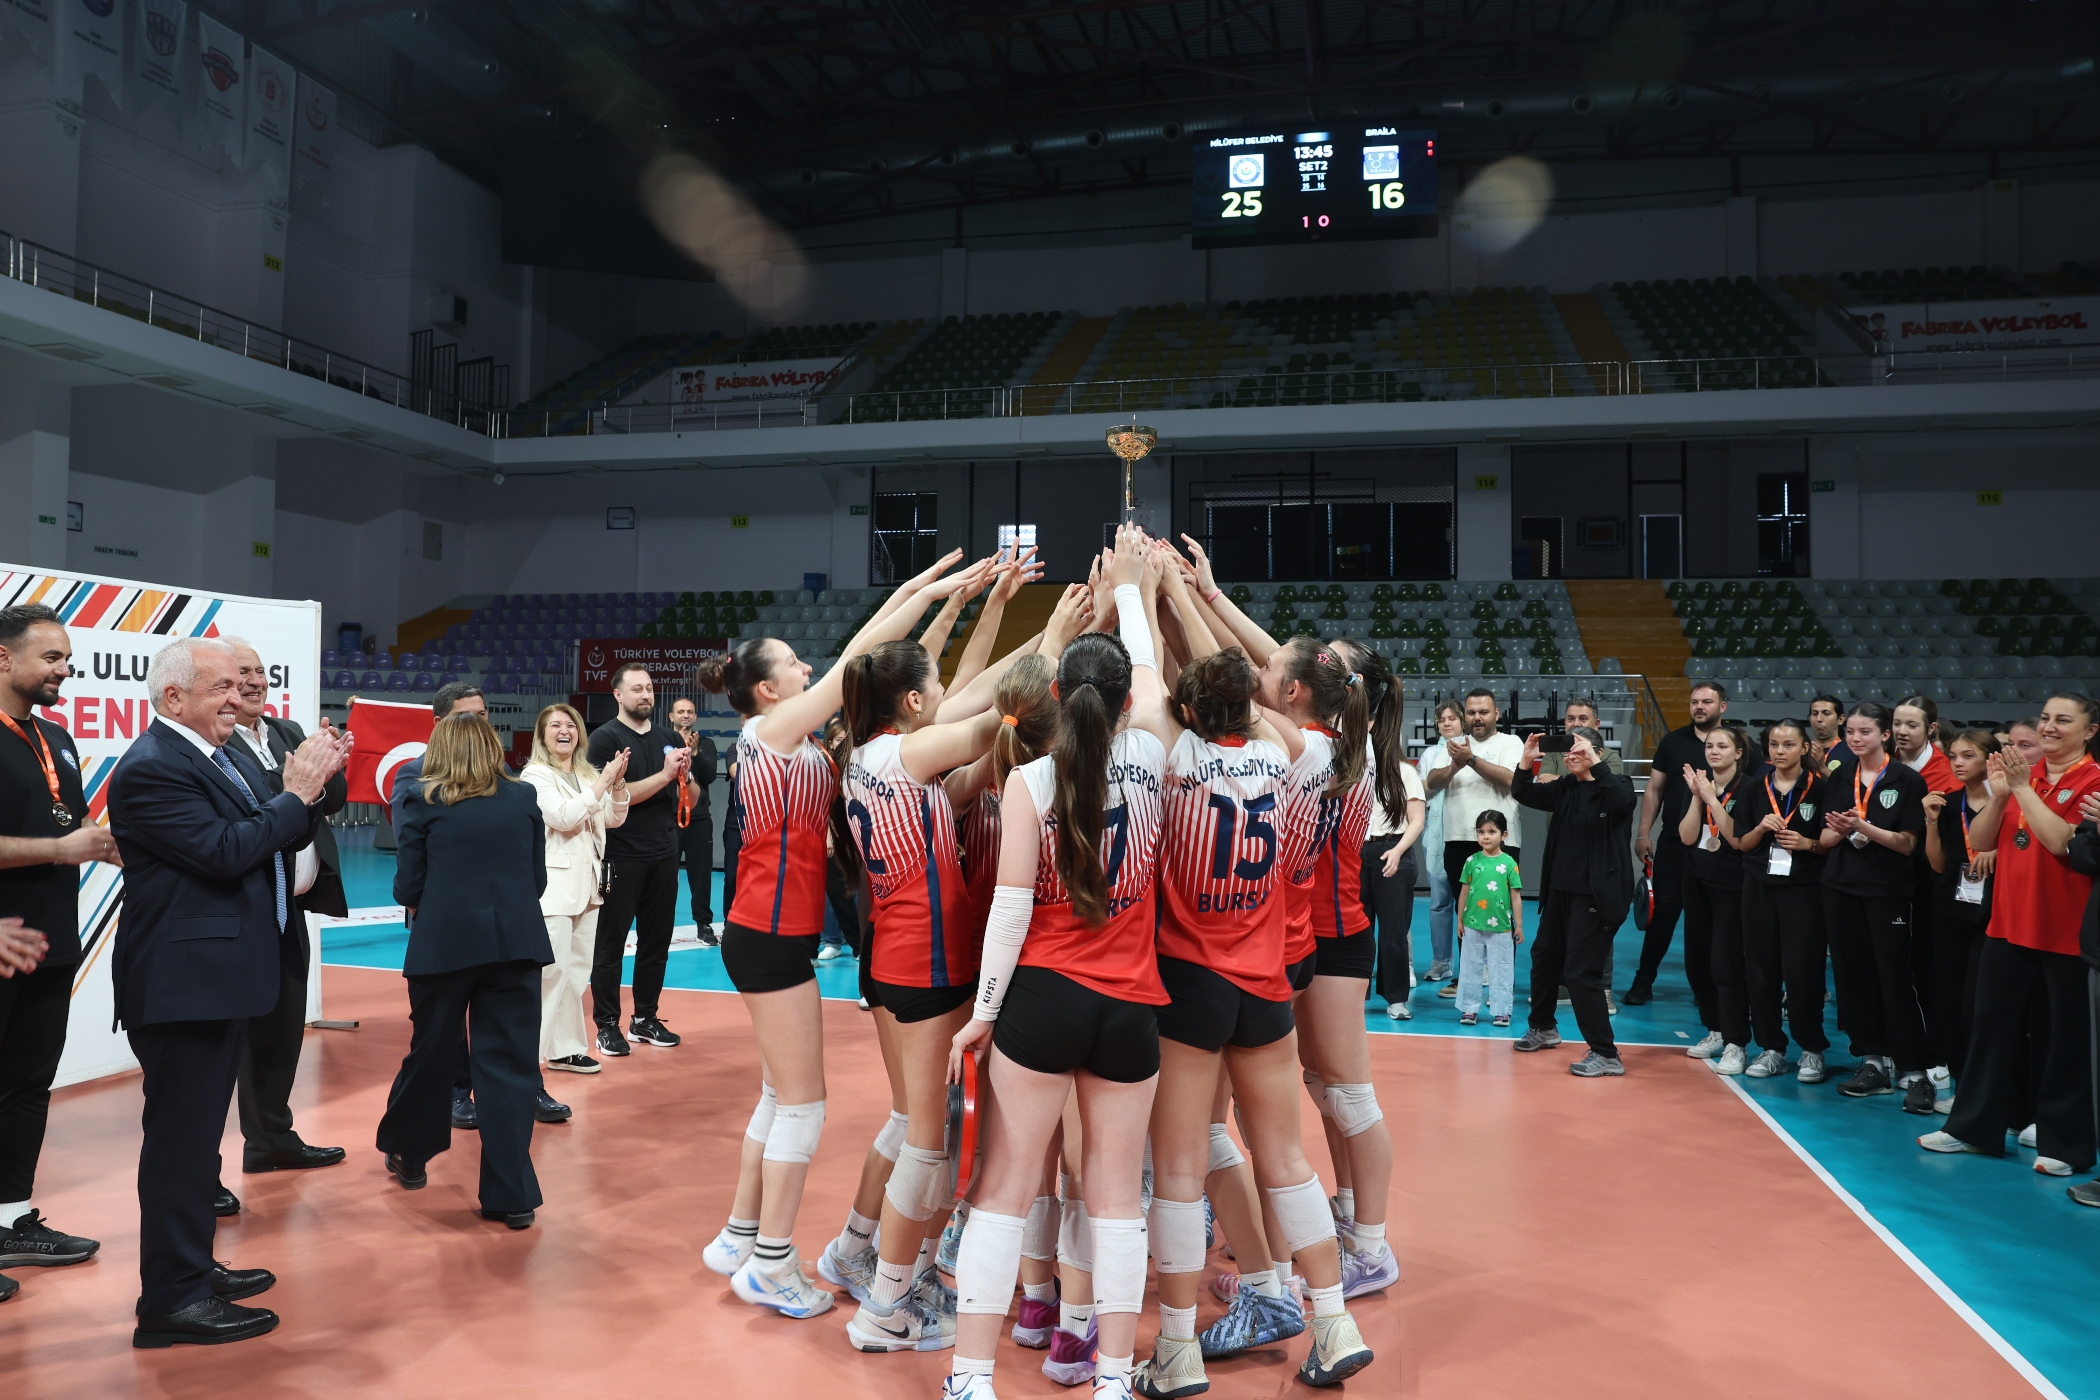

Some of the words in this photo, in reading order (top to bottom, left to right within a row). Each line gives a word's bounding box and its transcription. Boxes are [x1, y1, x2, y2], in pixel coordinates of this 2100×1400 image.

[1245, 134, 1284, 145] BELEDİYE
[1294, 145, 1333, 159] 13:45
[1299, 161, 1328, 172] SET2
[1368, 182, 1405, 210] 16
[1221, 190, 1263, 218] 25
[1302, 215, 1309, 228] 1
[1318, 214, 1330, 227] 0
[266, 257, 280, 270] 212
[1979, 311, 2088, 334] VOLEYBOL
[1478, 478, 1495, 487] 114
[1980, 494, 1999, 503] 115
[733, 518, 747, 526] 113
[94, 545, 114, 555] HAKEM
[255, 545, 268, 555] 112
[613, 647, 660, 659] TÜRKİYE
[584, 670, 608, 682] TVF
[847, 798, 886, 875] 2
[1208, 791, 1277, 881] 15
[982, 977, 998, 1004] KIPSTA
